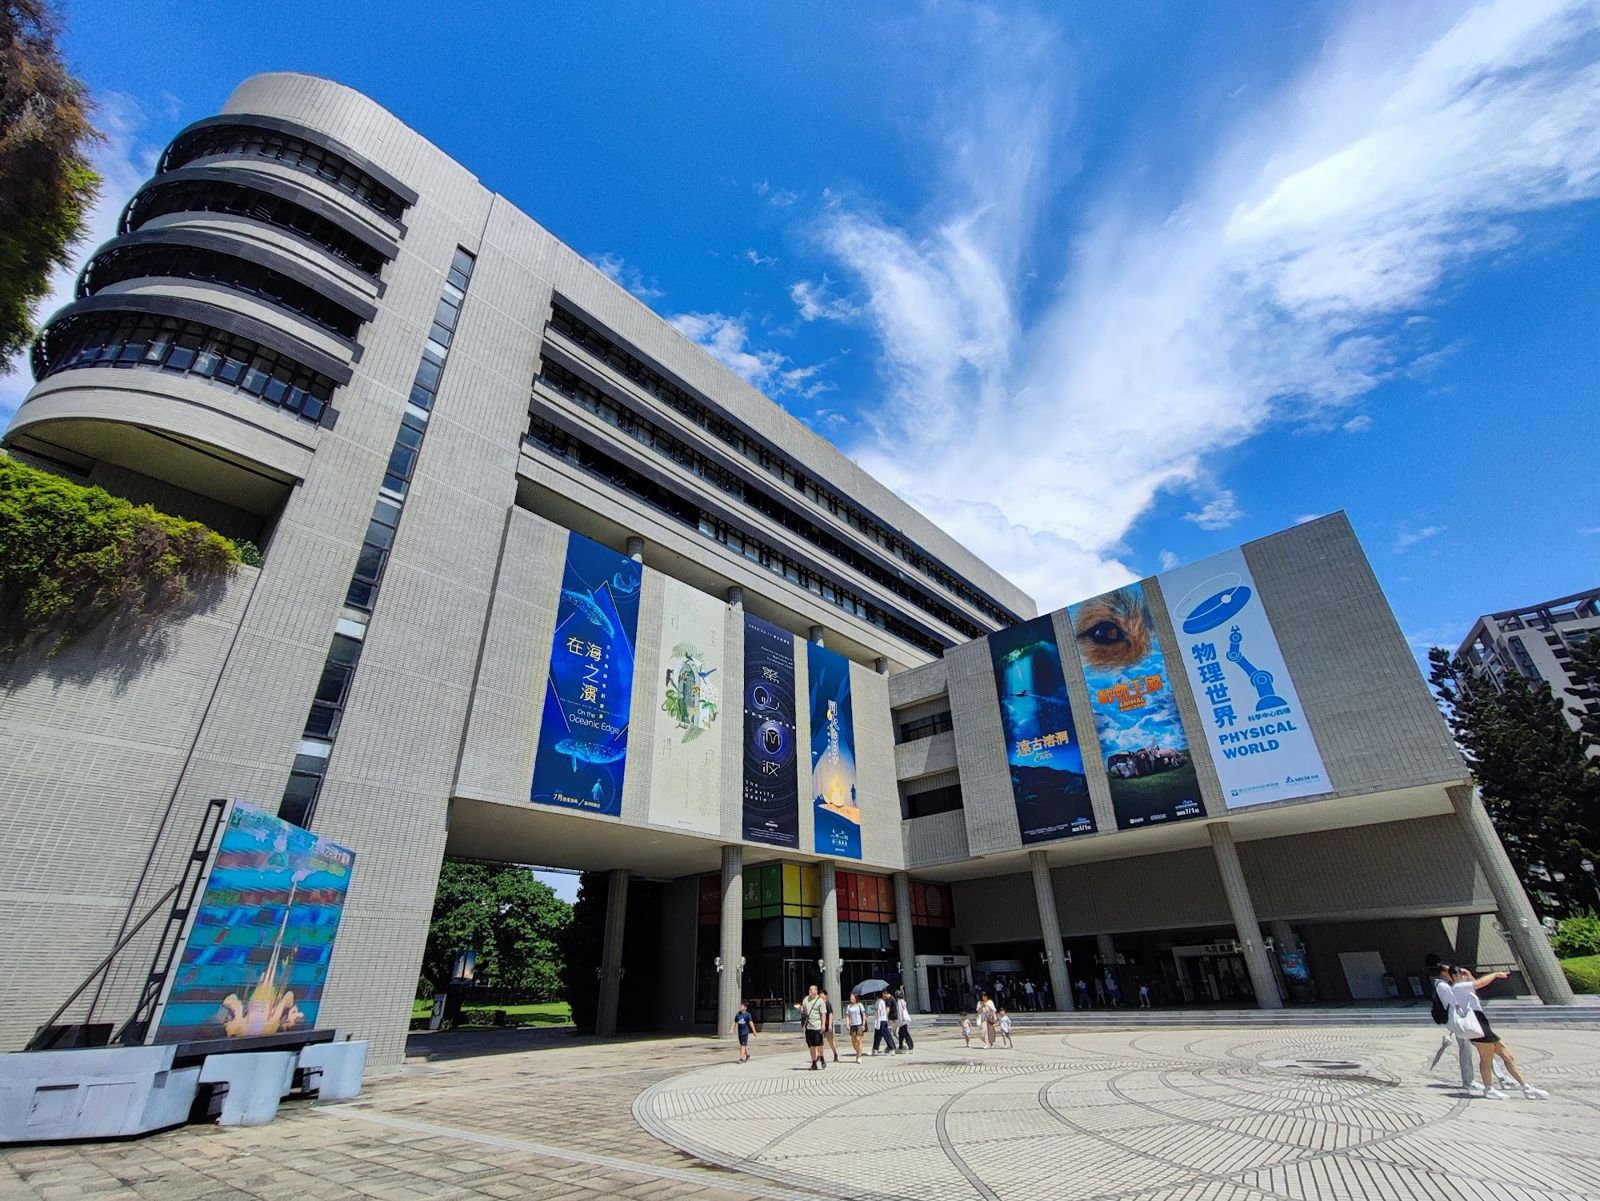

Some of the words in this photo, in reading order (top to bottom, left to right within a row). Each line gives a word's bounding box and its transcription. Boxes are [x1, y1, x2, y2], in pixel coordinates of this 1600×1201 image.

[1191, 642, 1237, 729] 物理世界
[577, 708, 586, 716] On
[568, 713, 600, 729] Oceanic
[601, 722, 620, 735] Edge
[1219, 720, 1298, 746] PHYSICAL
[1222, 739, 1280, 760] WORLD
